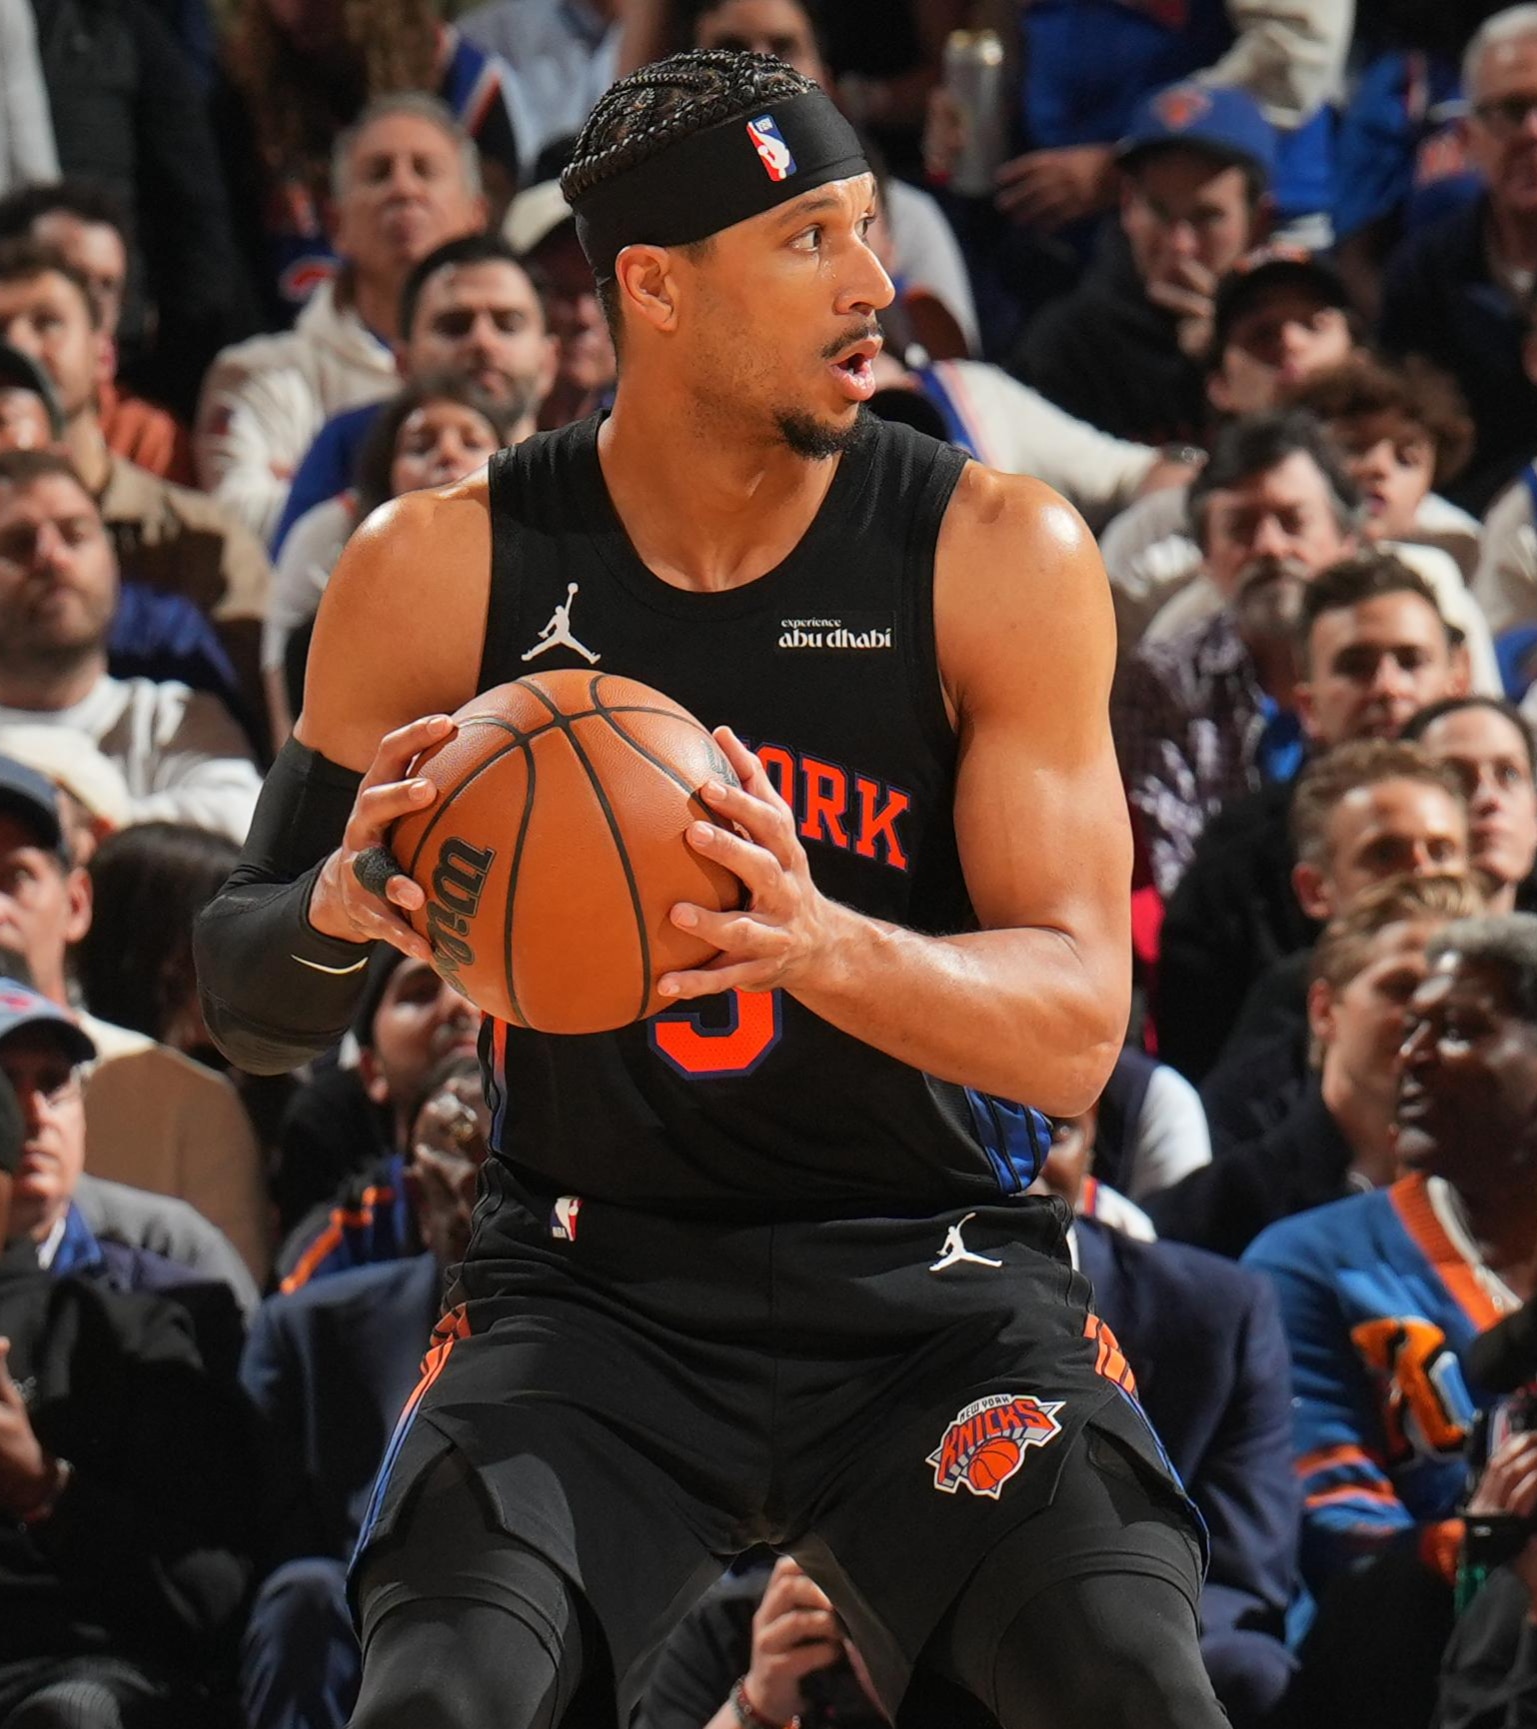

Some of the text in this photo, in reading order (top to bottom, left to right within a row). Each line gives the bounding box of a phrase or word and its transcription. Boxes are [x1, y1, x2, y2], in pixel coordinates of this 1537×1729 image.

[779, 628, 891, 648] abu dhabi
[781, 617, 841, 629] experience
[739, 736, 911, 872] ORK
[427, 836, 497, 1000] Wils
[960, 1396, 1010, 1423] NEW YORK
[937, 1398, 1055, 1484] KNICKS
